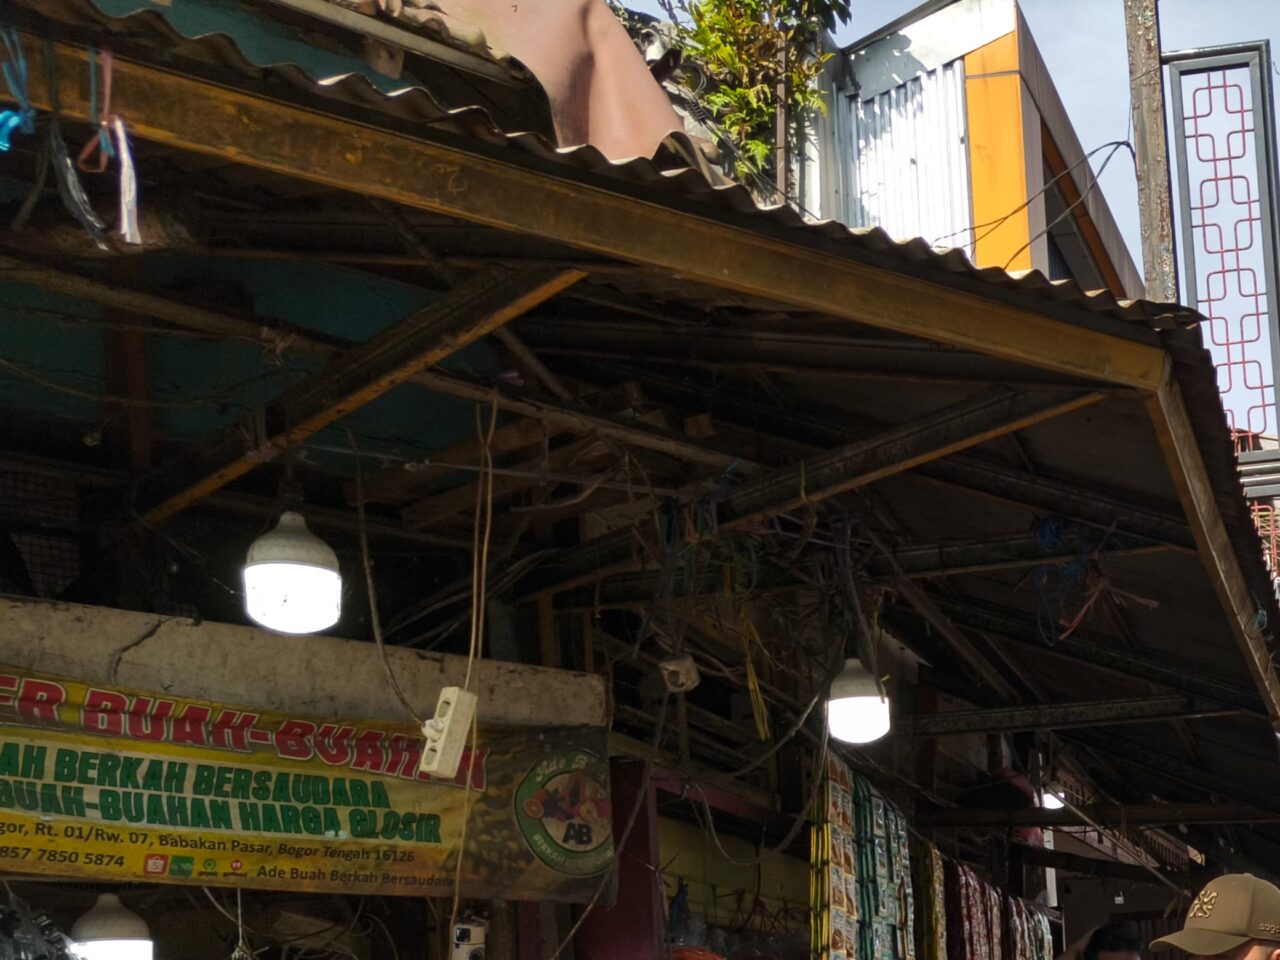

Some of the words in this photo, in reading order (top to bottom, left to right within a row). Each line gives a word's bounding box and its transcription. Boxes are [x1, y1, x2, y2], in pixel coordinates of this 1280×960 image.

[81, 688, 489, 792] BUAH-BUAHN
[54, 748, 188, 794] BERKAH
[193, 763, 392, 809] BERSAUDARA
[238, 801, 342, 838] HARGA
[562, 821, 594, 845] AB
[35, 822, 58, 837] Rt.
[64, 825, 124, 843] 01/Rw.
[129, 832, 153, 847] 07,
[159, 835, 226, 852] Babakan
[231, 840, 272, 856] Pasar,
[278, 843, 319, 858] Bogor
[323, 845, 370, 862] Tengah
[376, 849, 415, 863] 16126
[37, 849, 79, 865] 7850
[83, 852, 125, 868] 5874
[256, 865, 287, 879] Ade
[291, 868, 326, 882] Buah
[330, 870, 378, 885] Berkah
